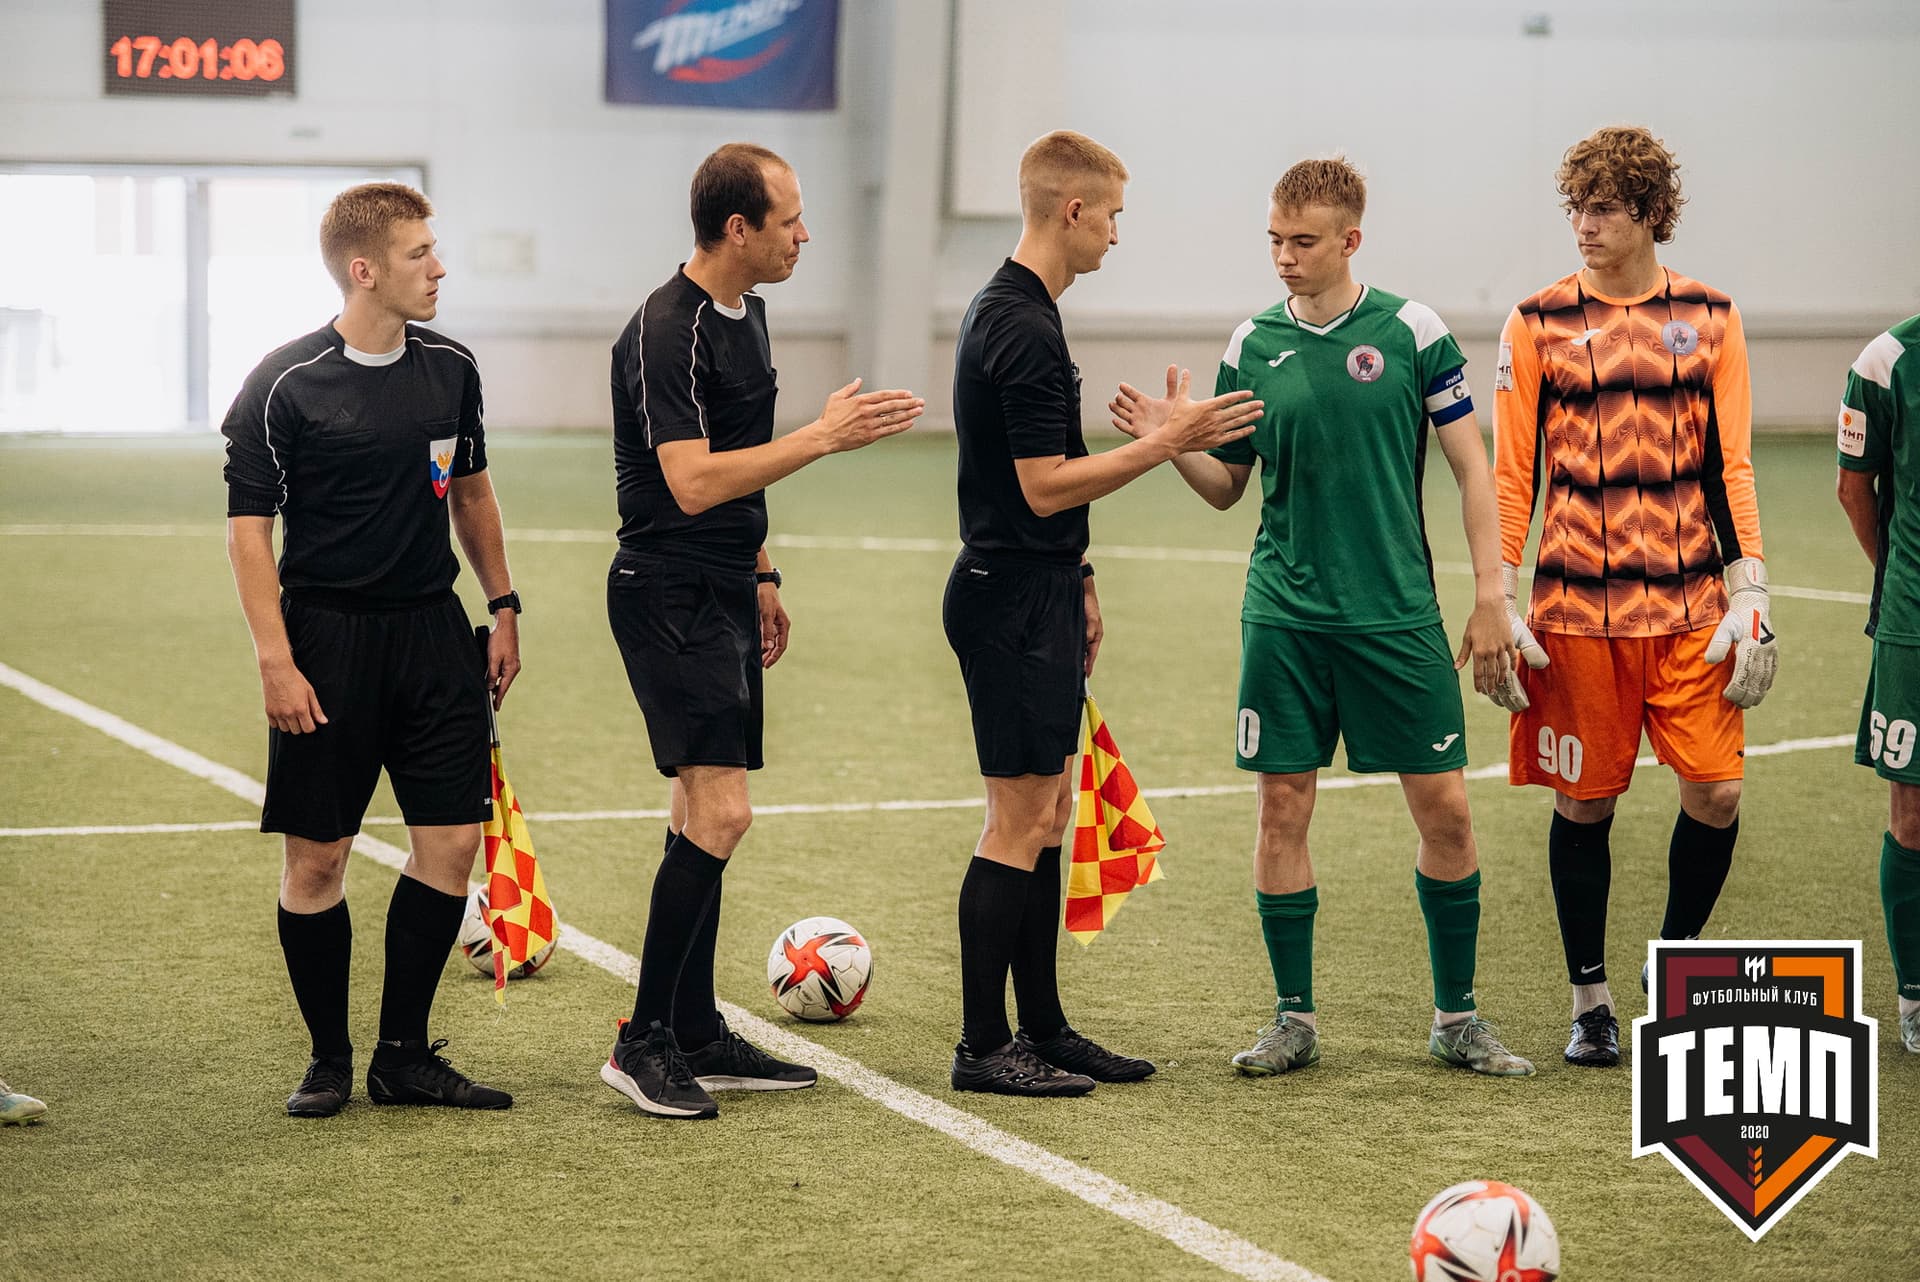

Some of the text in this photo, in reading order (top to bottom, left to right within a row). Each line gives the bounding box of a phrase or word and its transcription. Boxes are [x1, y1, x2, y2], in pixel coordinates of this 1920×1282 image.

[110, 36, 285, 81] 17:01:06
[1538, 726, 1583, 783] 90
[1870, 710, 1917, 769] 69
